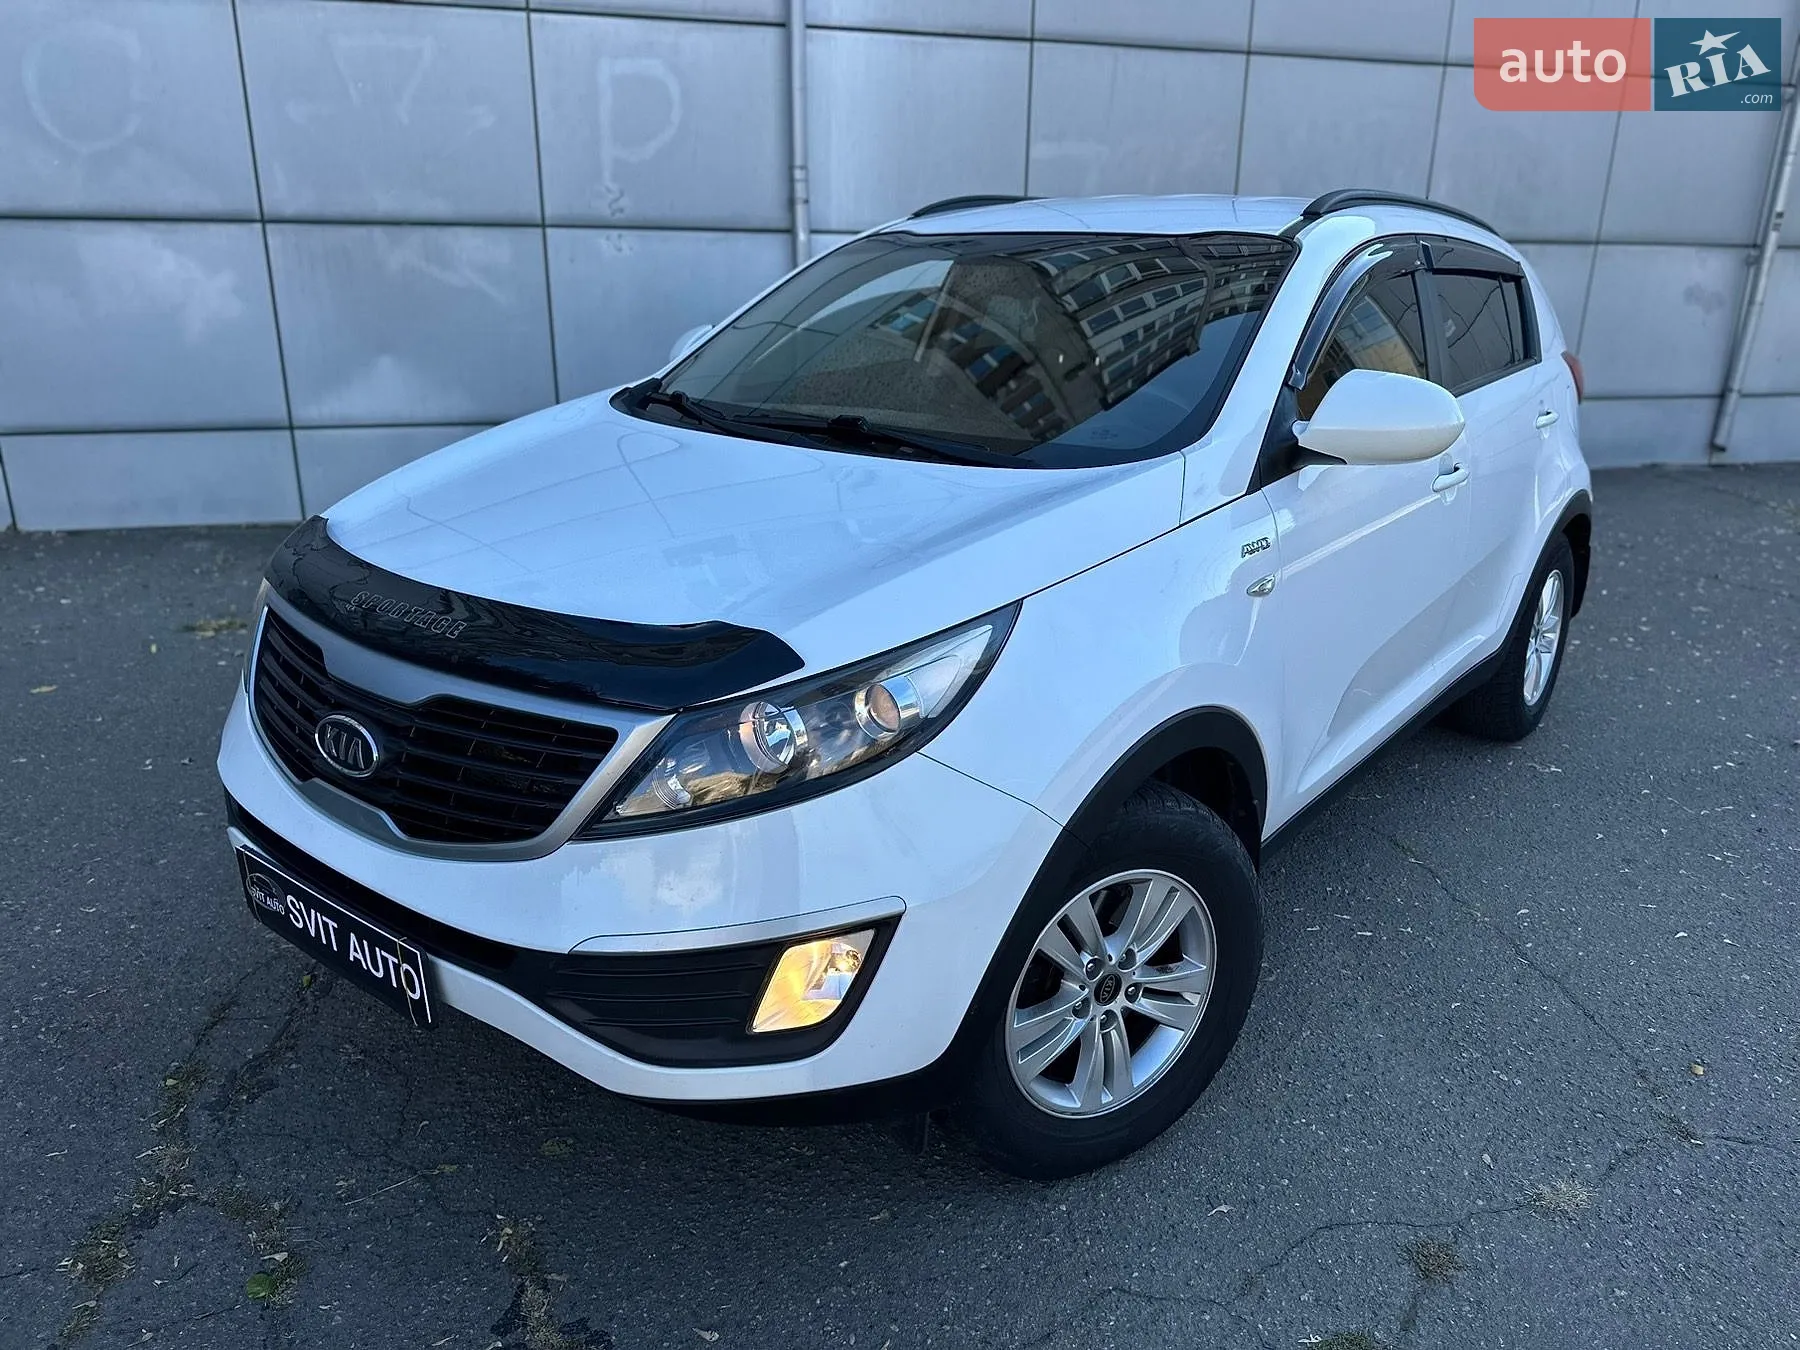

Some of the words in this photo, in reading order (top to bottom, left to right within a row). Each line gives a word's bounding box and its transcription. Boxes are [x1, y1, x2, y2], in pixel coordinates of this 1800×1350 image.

[1241, 536, 1271, 559] AWD
[350, 591, 467, 639] SPORTAGE
[324, 723, 365, 769] KIA
[286, 894, 338, 952] SVIT
[349, 932, 421, 1000] AUTO
